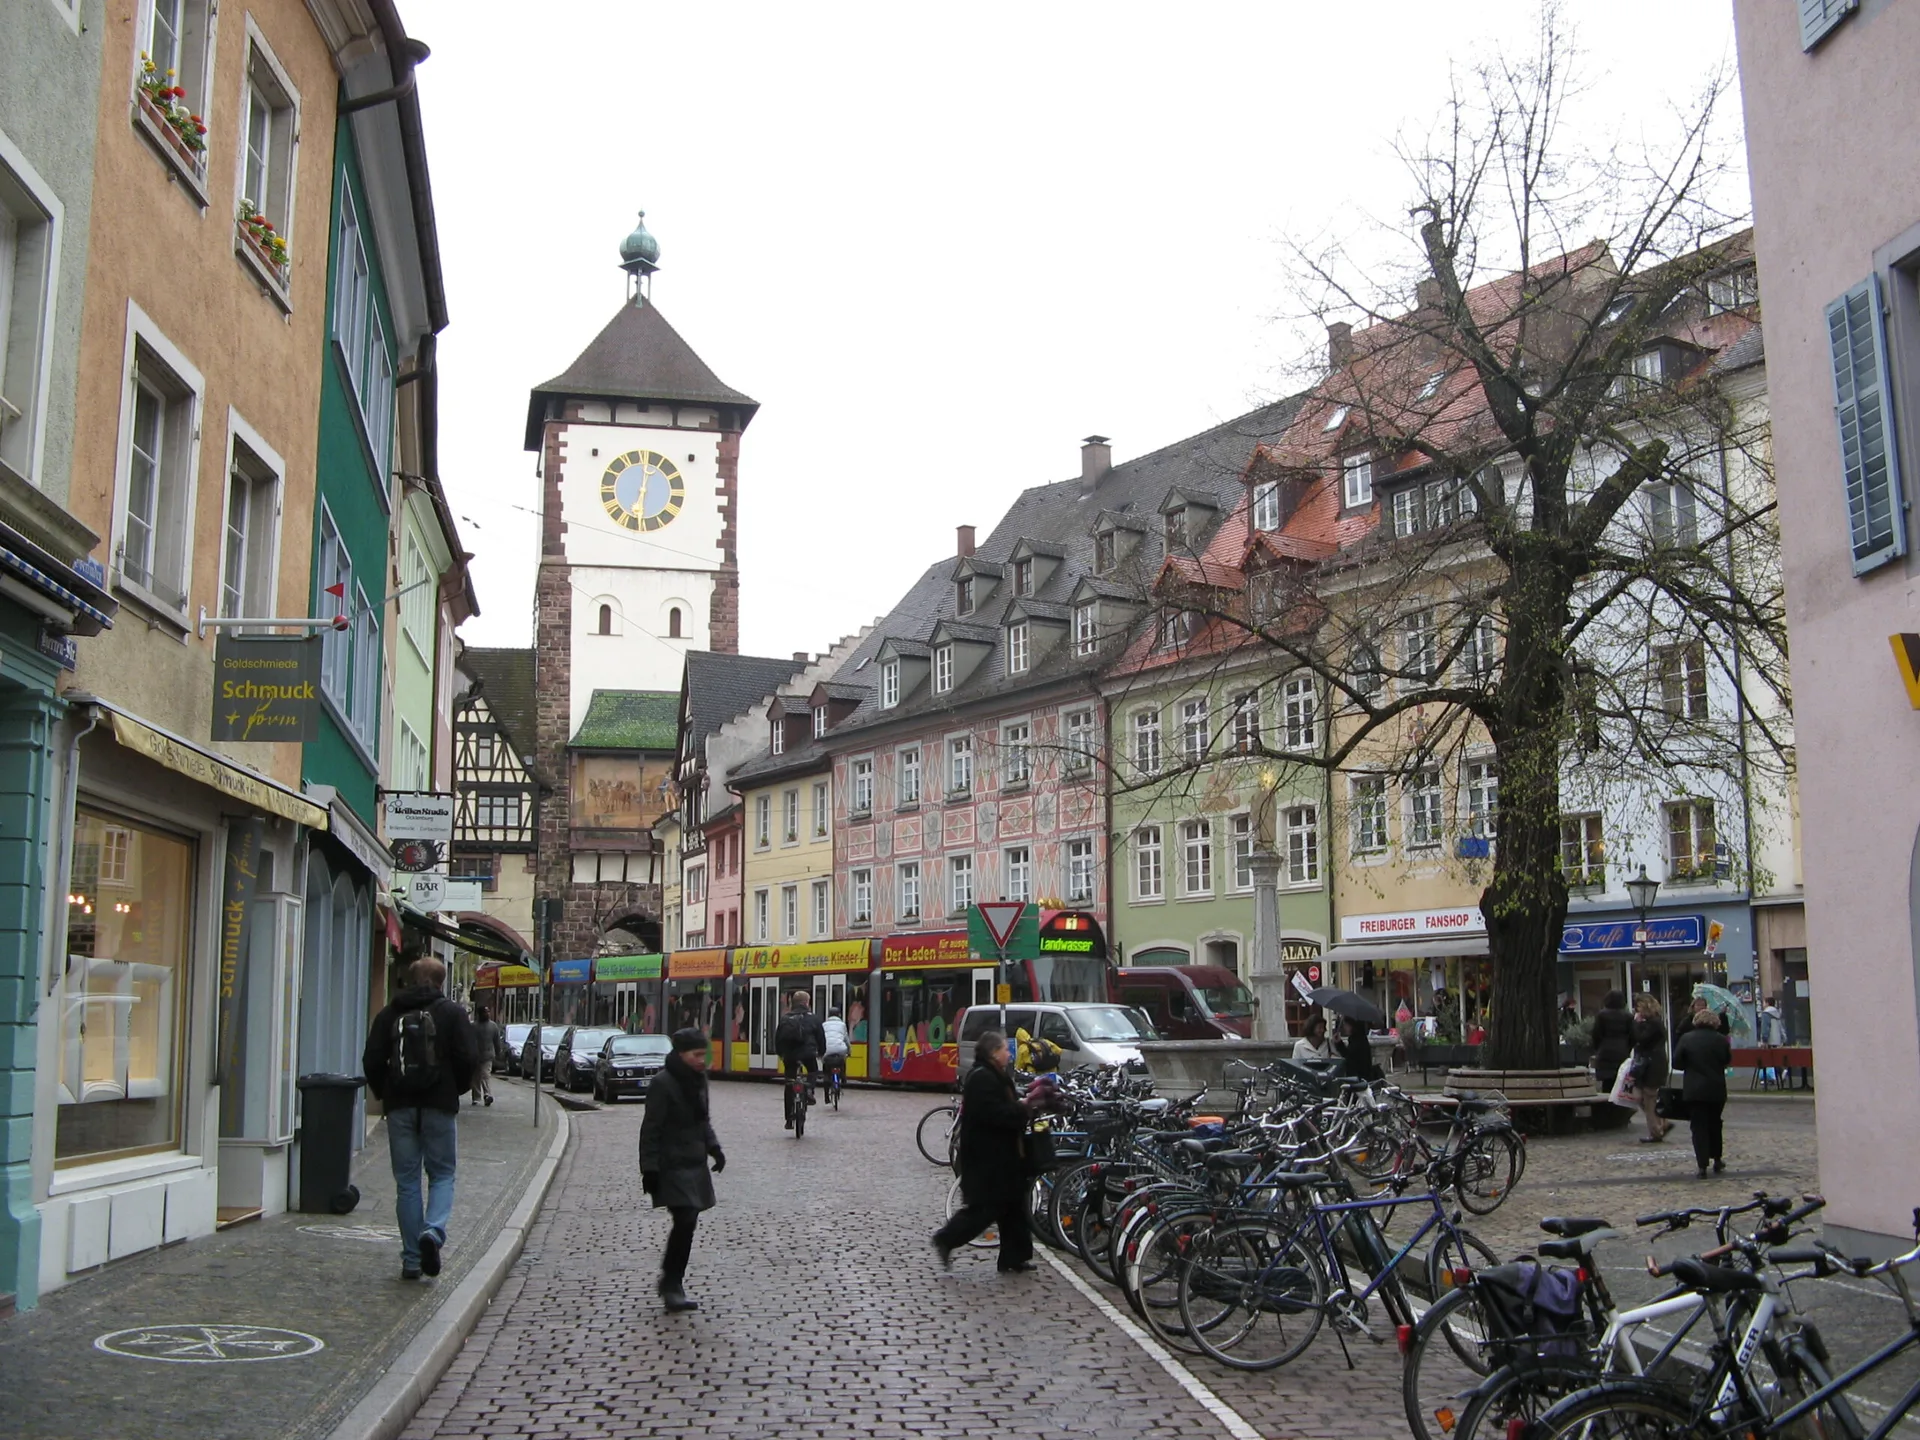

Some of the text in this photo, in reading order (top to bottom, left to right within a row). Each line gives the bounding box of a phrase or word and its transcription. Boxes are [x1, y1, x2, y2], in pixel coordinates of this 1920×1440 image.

[223, 658, 298, 669] Goldschmiede
[223, 680, 315, 699] Schmuck
[1360, 914, 1469, 933] FREIBURGER FANSHOP
[1040, 937, 1093, 952] Landwasser
[803, 954, 829, 967] starke
[830, 941, 866, 965] Kinder!
[885, 946, 937, 962] Der Laden
